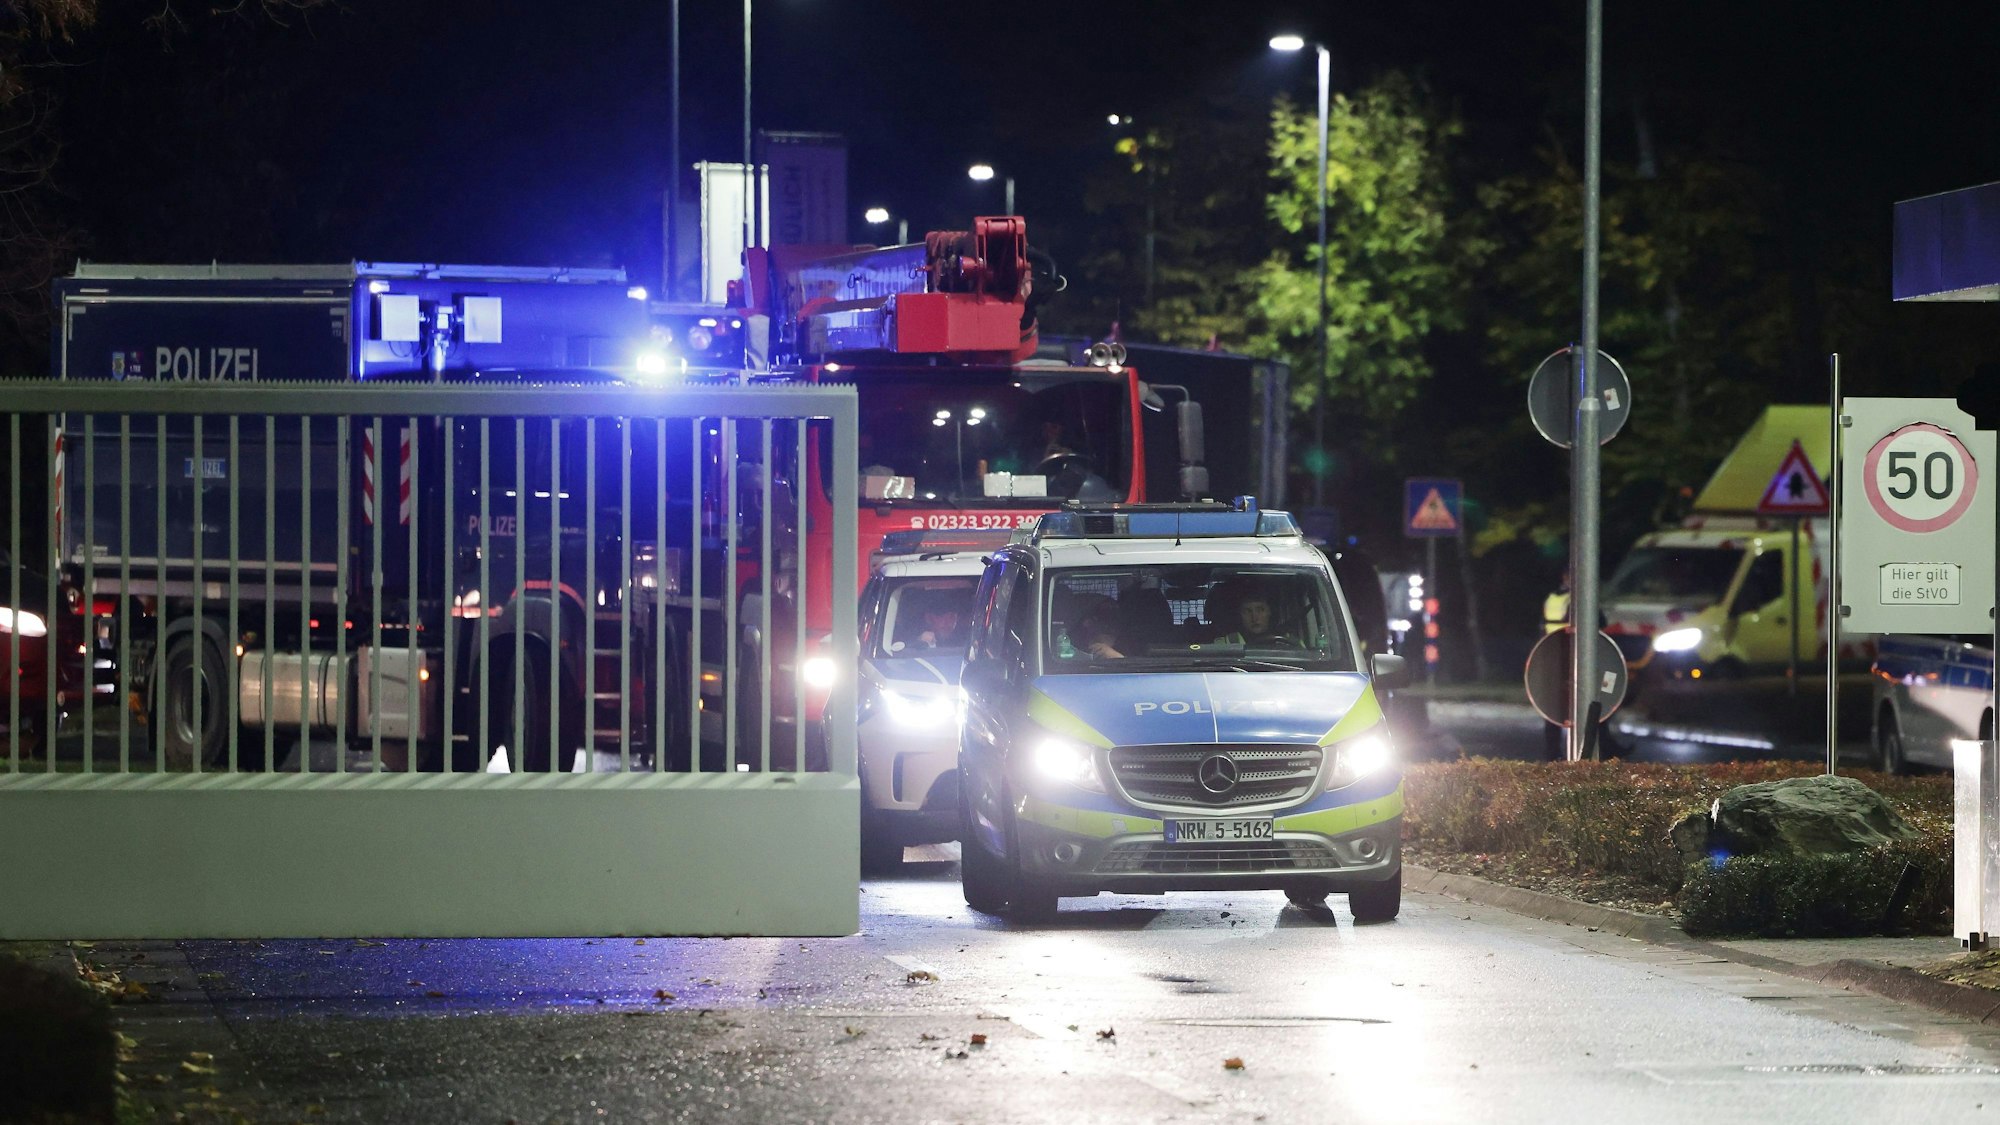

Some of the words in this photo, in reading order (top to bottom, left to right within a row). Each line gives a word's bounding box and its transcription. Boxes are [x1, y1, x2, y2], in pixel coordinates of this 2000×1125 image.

[1888, 451, 1954, 500] 50
[928, 515, 977, 530] 02323
[982, 515, 1011, 530] 922
[1892, 568, 1921, 580] Hier
[1926, 568, 1948, 583] gilt
[1892, 587, 1912, 599] die
[1917, 587, 1948, 600] StVO
[1176, 822, 1206, 839] NRW
[1215, 822, 1272, 839] 5-5162
